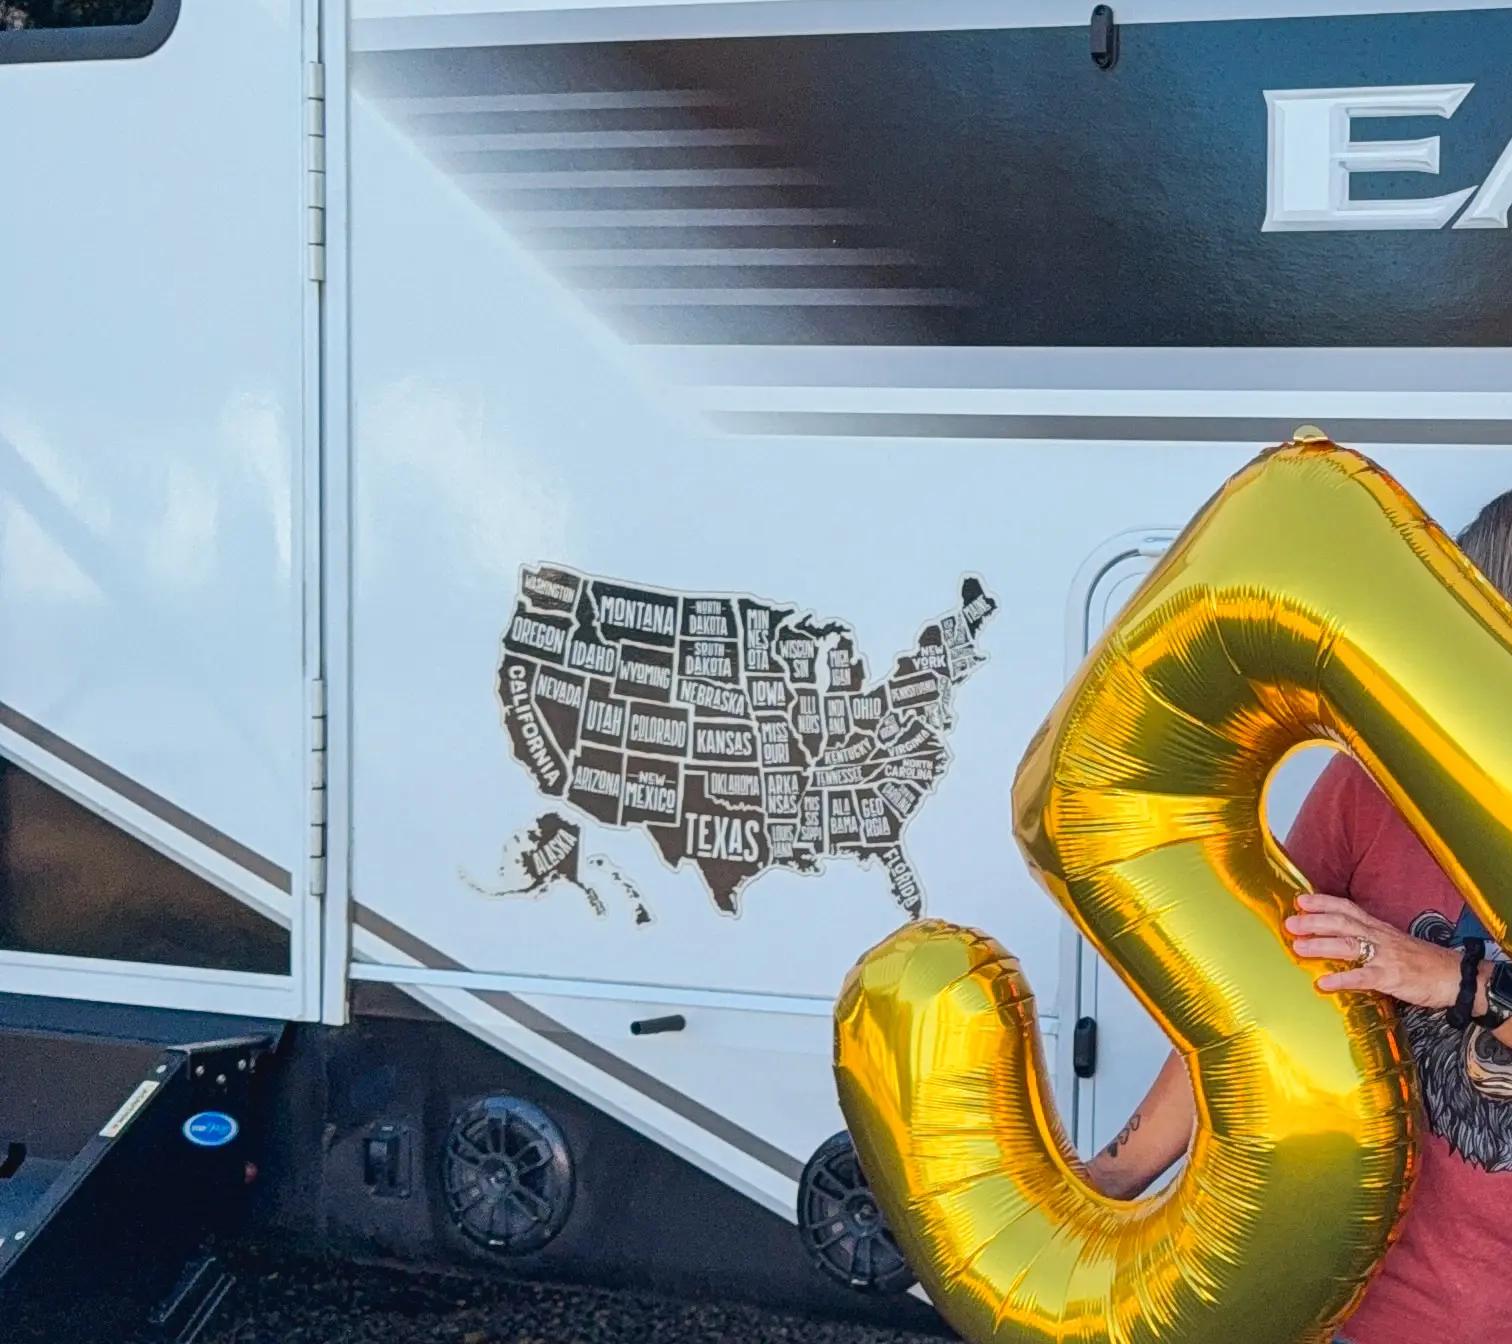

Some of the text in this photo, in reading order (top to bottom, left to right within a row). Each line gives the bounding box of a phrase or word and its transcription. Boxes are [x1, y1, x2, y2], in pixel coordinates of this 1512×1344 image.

[600, 595, 674, 636] MONTANA
[689, 615, 728, 636] DAKOTA
[746, 609, 770, 630] MIN
[511, 616, 566, 654] OREGON
[747, 630, 769, 649] NES
[571, 640, 615, 673] IDAHO
[694, 642, 725, 657] SOUTH
[747, 649, 769, 670] OTA
[921, 645, 943, 656] NEW
[685, 656, 731, 677] DAKOTA
[912, 655, 946, 670] YORK
[619, 660, 671, 689] WYOMING
[537, 674, 582, 709] NEVADA
[680, 680, 745, 716] NEBRASKA
[752, 680, 786, 706] IOWA
[585, 700, 623, 737] UTAH
[853, 698, 881, 719] OHIO
[507, 664, 560, 787] CALIFORNIA
[630, 713, 687, 748] COLORADO
[761, 722, 788, 743] MISS
[696, 729, 752, 756] KANSAS
[764, 743, 790, 764] OURI
[824, 738, 873, 765] KENTUCKY
[887, 729, 930, 757] VIRGINIA
[884, 765, 933, 780] CAROLINA
[903, 759, 933, 769] NORTH
[573, 765, 620, 797] ARIZONA
[638, 771, 666, 786] NEW
[711, 772, 760, 796] OKLAHOMA
[768, 774, 799, 795] ARKA
[815, 766, 863, 786] TENNESSEE
[624, 781, 676, 814] MEXICO
[768, 795, 797, 814] NSAS
[832, 798, 851, 816] ALA
[830, 816, 859, 834] BAMA
[685, 812, 760, 862] TEXAS
[532, 829, 577, 876] ALASKA
[883, 848, 919, 908] FLORIDA
